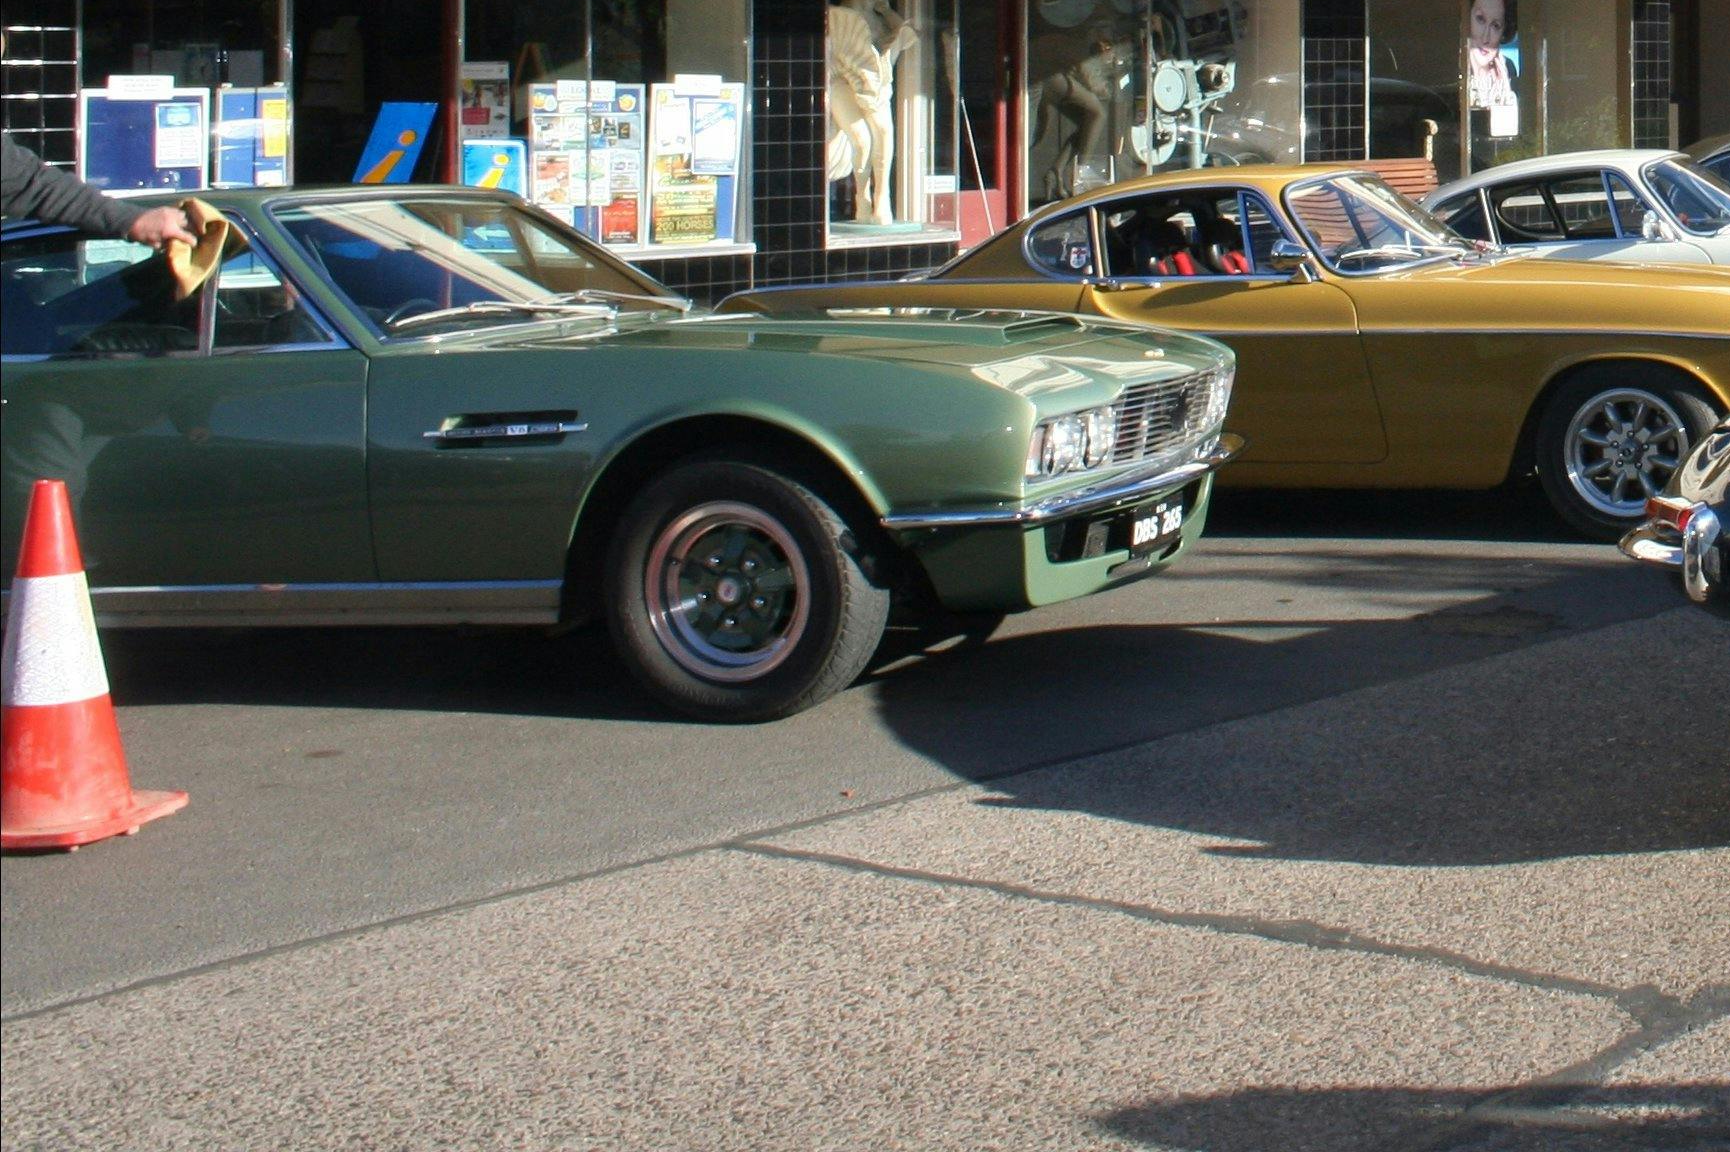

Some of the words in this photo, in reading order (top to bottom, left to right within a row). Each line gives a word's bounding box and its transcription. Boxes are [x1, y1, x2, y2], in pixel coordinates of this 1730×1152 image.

[676, 219, 715, 230] HORSES
[1133, 515, 1159, 546] DBS
[1162, 505, 1183, 535] 265
